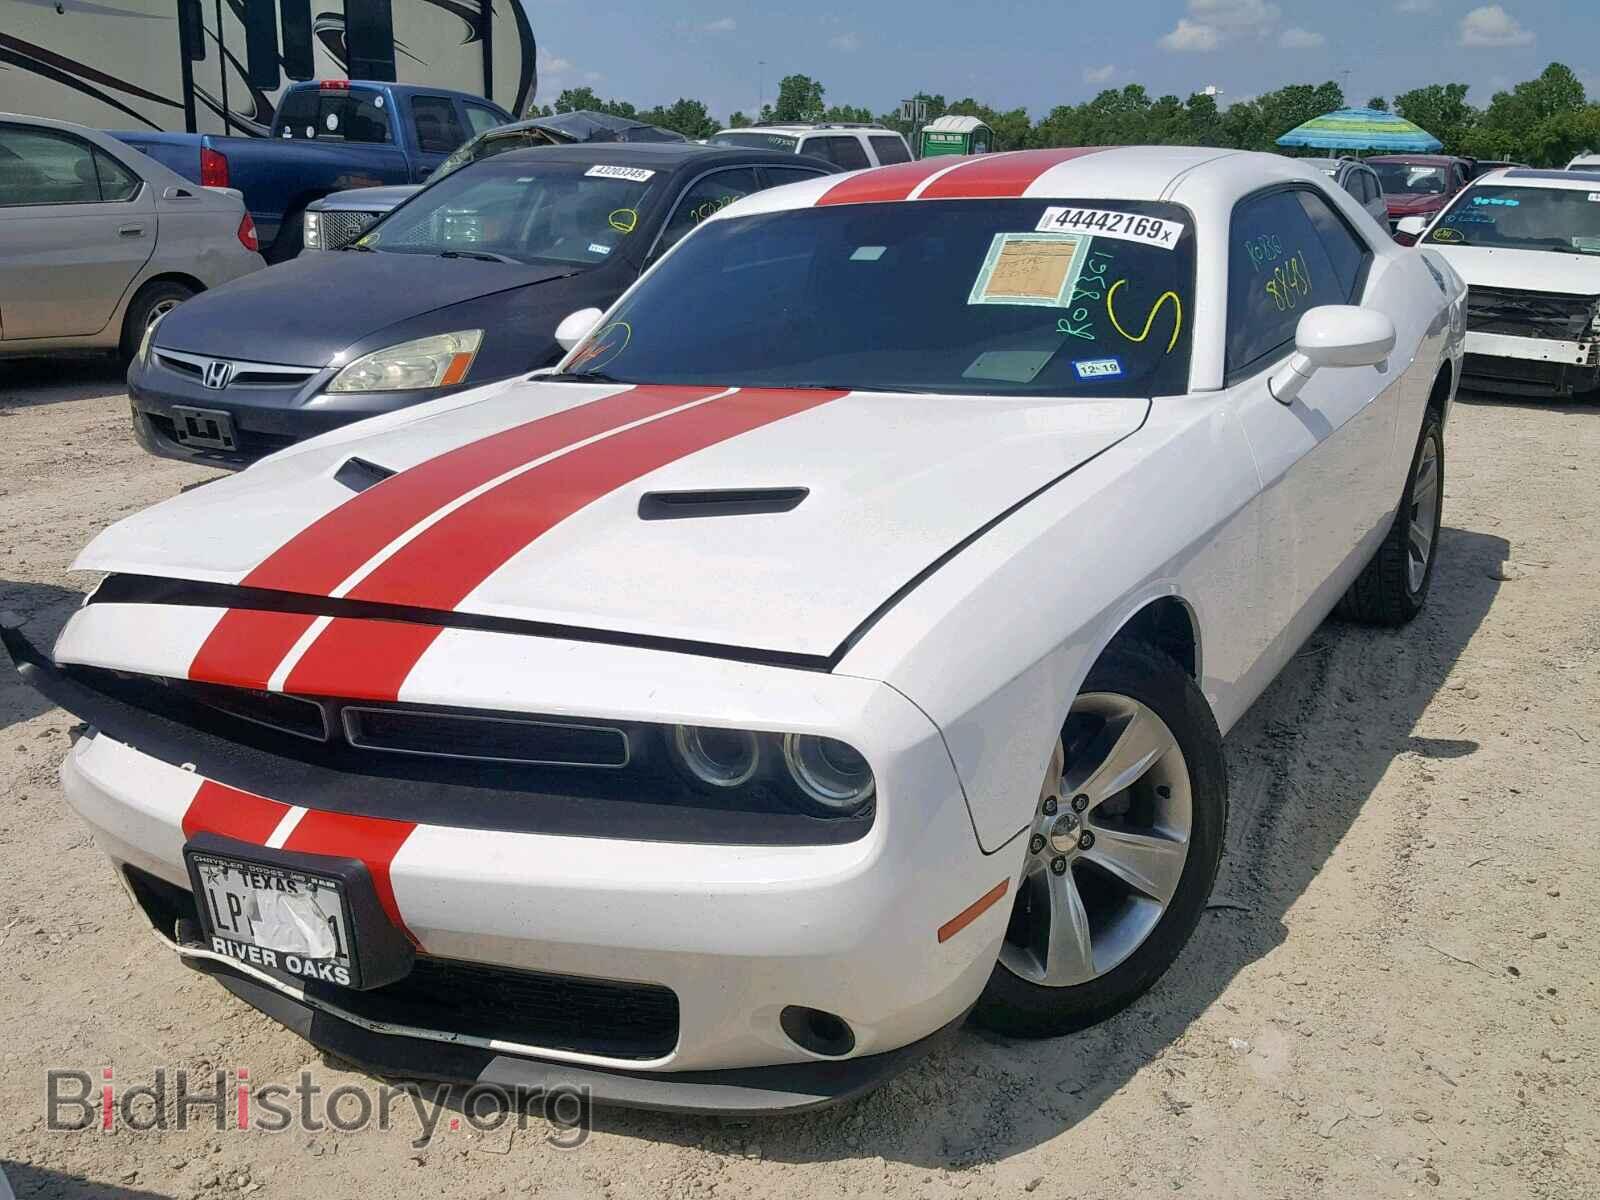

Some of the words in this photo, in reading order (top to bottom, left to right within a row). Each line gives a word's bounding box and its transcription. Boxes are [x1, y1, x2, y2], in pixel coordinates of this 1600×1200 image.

[193, 855, 244, 870] CHRYSLER
[239, 871, 298, 894] TEXAS
[211, 936, 278, 968] RIVER
[285, 956, 351, 986] OAKS
